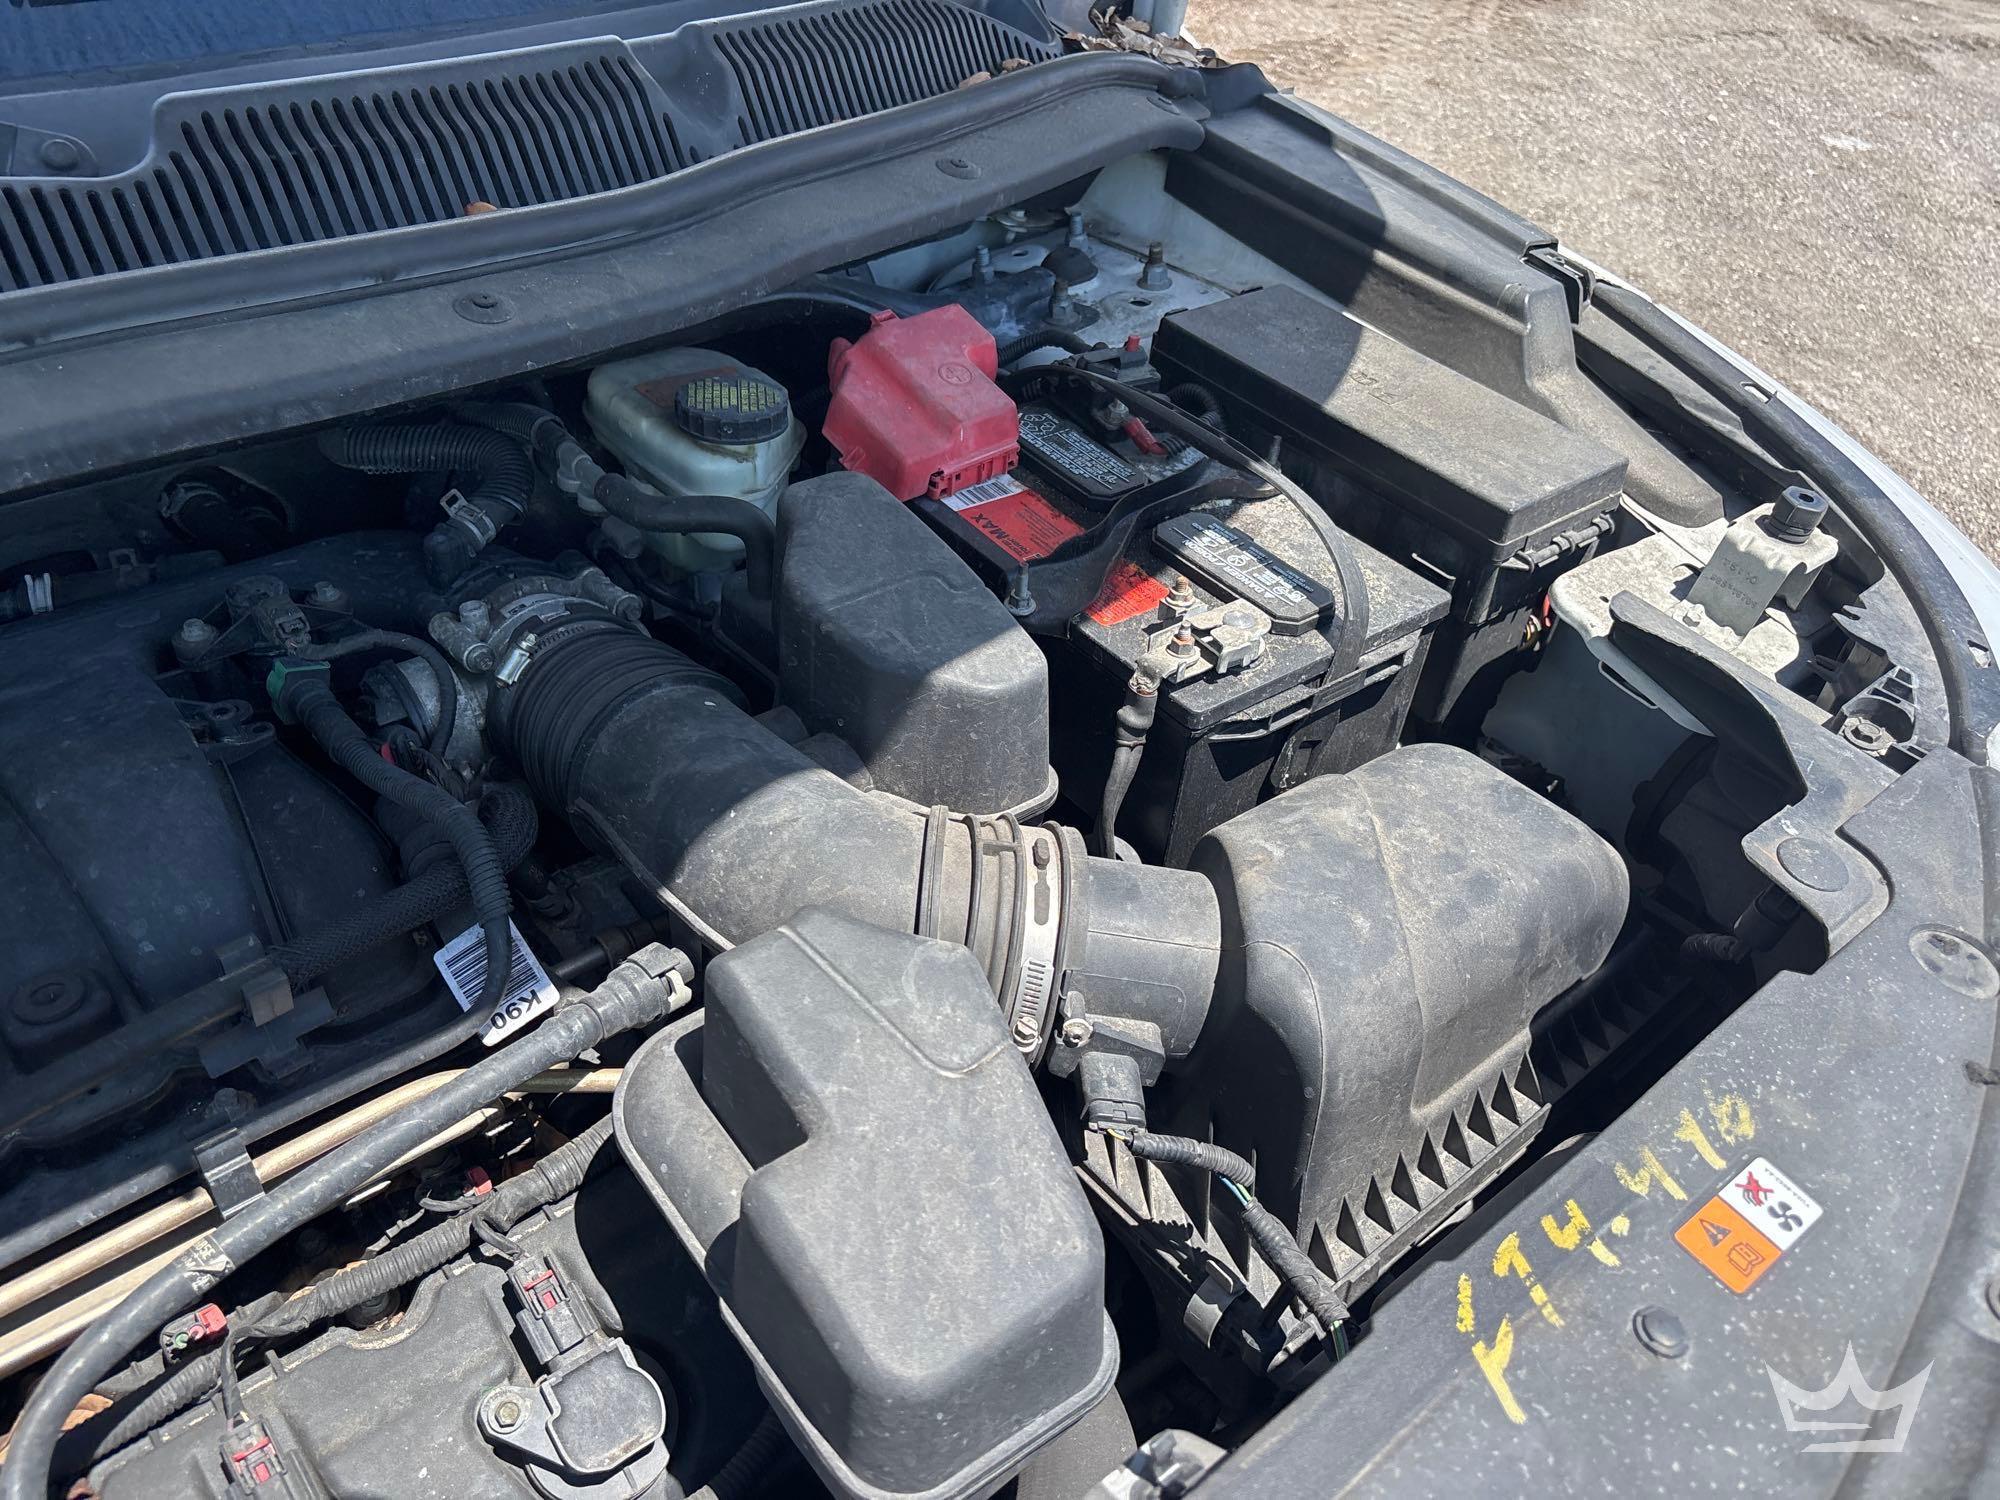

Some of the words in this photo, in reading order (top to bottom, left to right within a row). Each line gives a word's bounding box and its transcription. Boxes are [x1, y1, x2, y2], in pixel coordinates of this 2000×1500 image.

[970, 512, 1009, 540] MAX
[1181, 539, 1220, 566] POISON
[1223, 566, 1265, 593] DANGER
[491, 988, 542, 1030] K90
